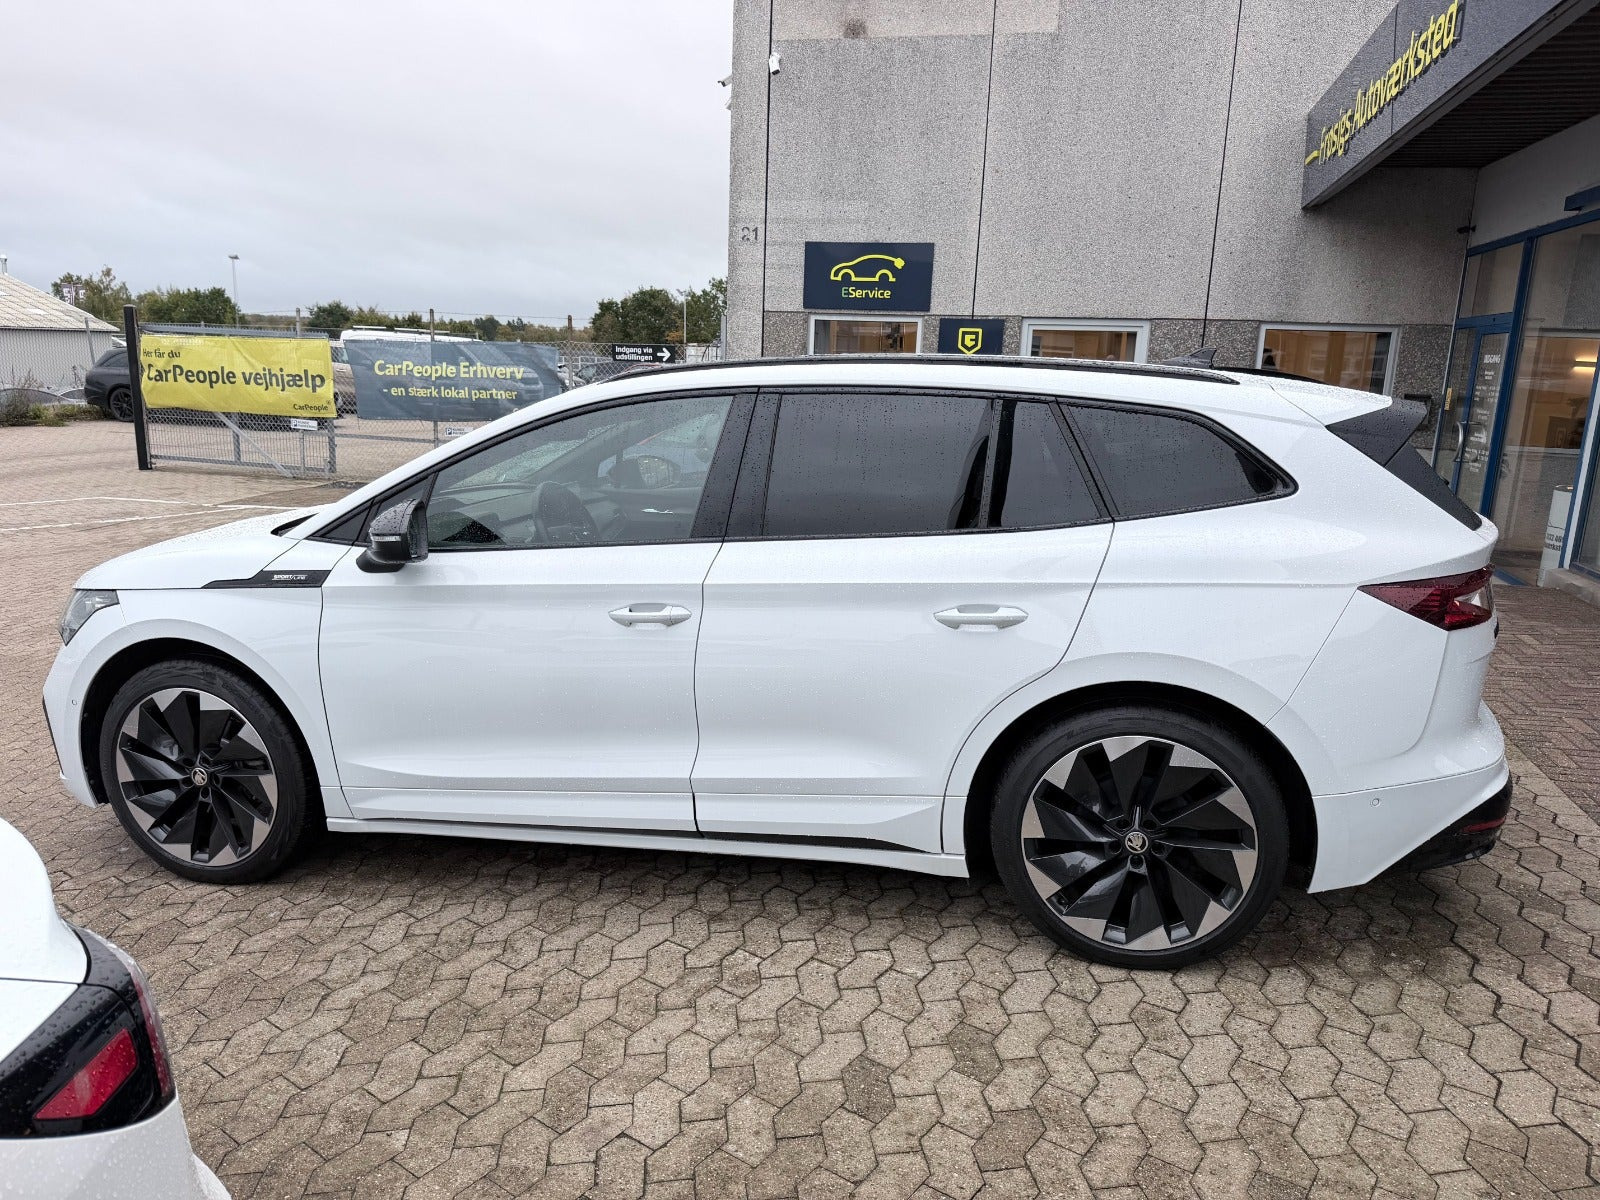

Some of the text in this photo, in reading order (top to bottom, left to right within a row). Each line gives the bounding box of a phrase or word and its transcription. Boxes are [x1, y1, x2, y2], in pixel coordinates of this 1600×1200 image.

[1352, 0, 1460, 134] Autoværksted
[741, 226, 759, 241] 21
[841, 287, 891, 299] EService
[143, 346, 181, 359] Her får du
[615, 346, 653, 354] Indgang via
[615, 354, 653, 362] udstillingen
[374, 359, 525, 381] CarPeople Erhverv
[147, 363, 326, 393] CarPeople vejhjælp
[391, 387, 405, 396] en
[408, 386, 438, 398] stærk
[441, 387, 469, 399] lokal
[471, 388, 518, 401] partner
[293, 404, 329, 412] CarPeople
